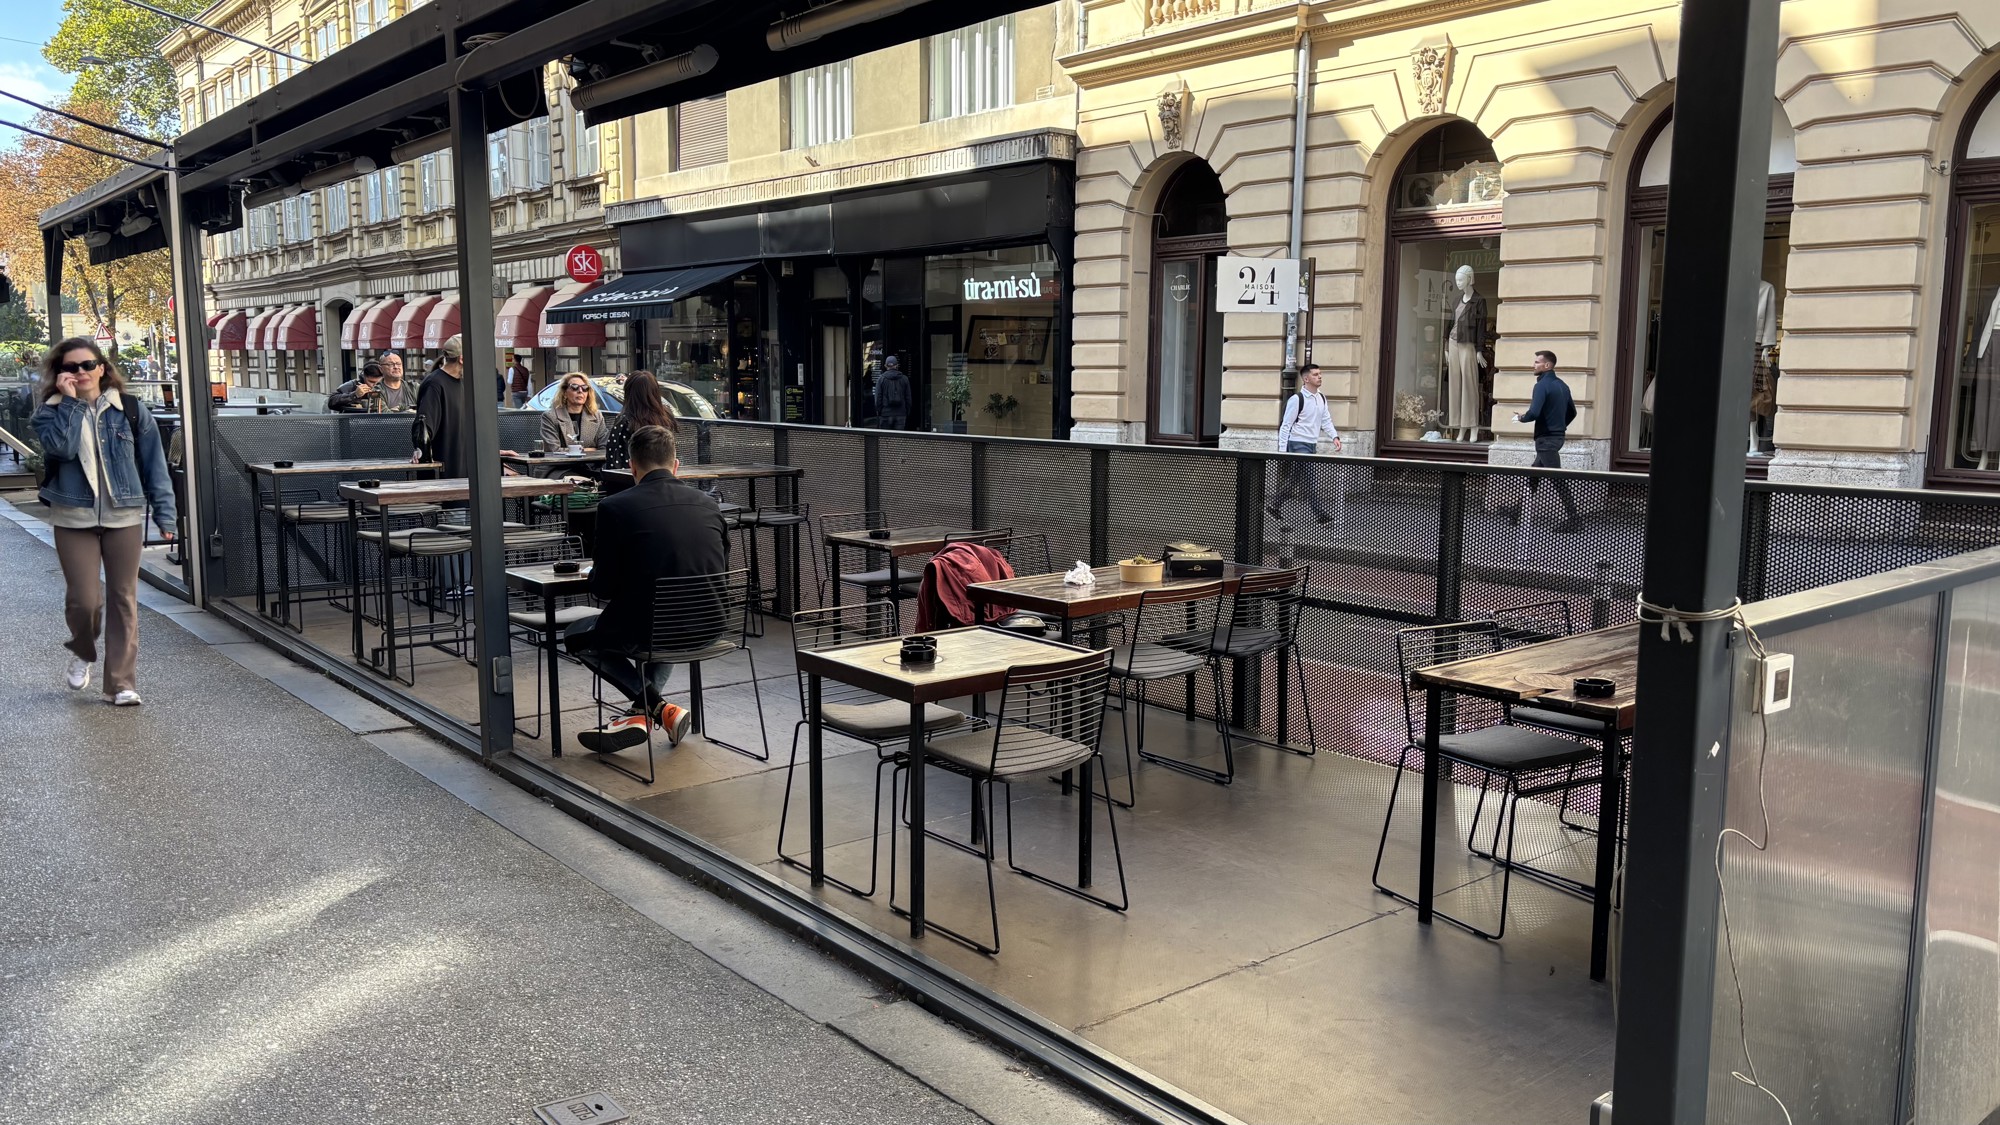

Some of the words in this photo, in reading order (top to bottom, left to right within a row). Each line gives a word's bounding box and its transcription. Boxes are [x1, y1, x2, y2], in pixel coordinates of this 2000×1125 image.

[1237, 265, 1280, 306] 24
[582, 312, 608, 320] PORSCHE
[609, 311, 630, 319] DESIGN
